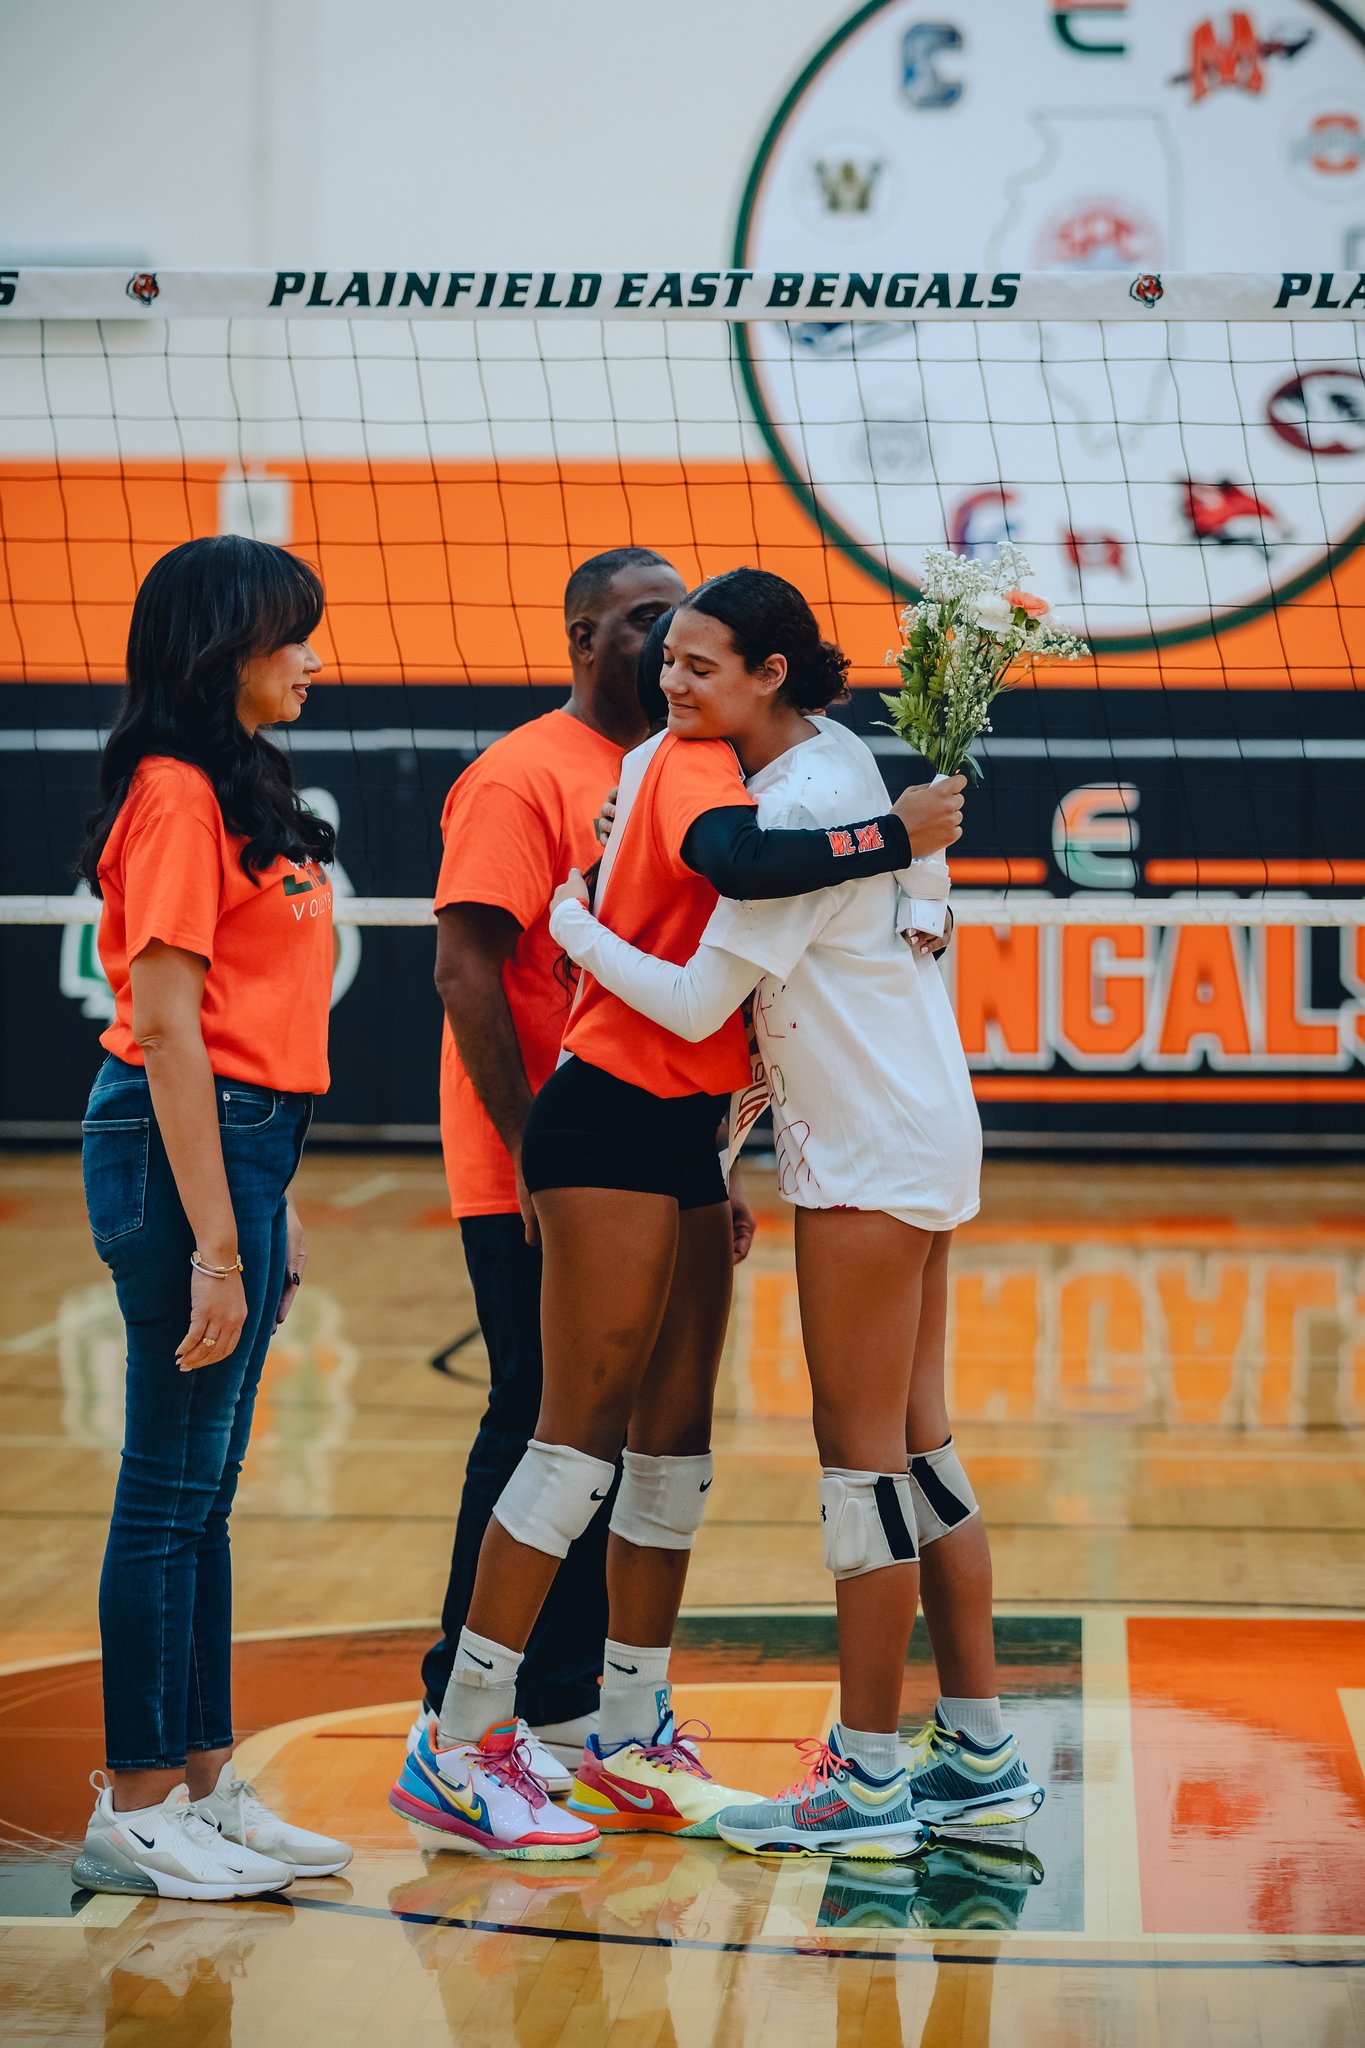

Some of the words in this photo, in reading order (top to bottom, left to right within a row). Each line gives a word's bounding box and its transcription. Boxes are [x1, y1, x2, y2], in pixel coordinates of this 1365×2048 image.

[268, 271, 603, 308] PLAINFIELD
[614, 272, 753, 308] EAST
[766, 272, 1021, 308] BENGALS
[825, 830, 857, 857] WE
[853, 822, 885, 853] ARE
[947, 890, 1365, 1072] NGAL
